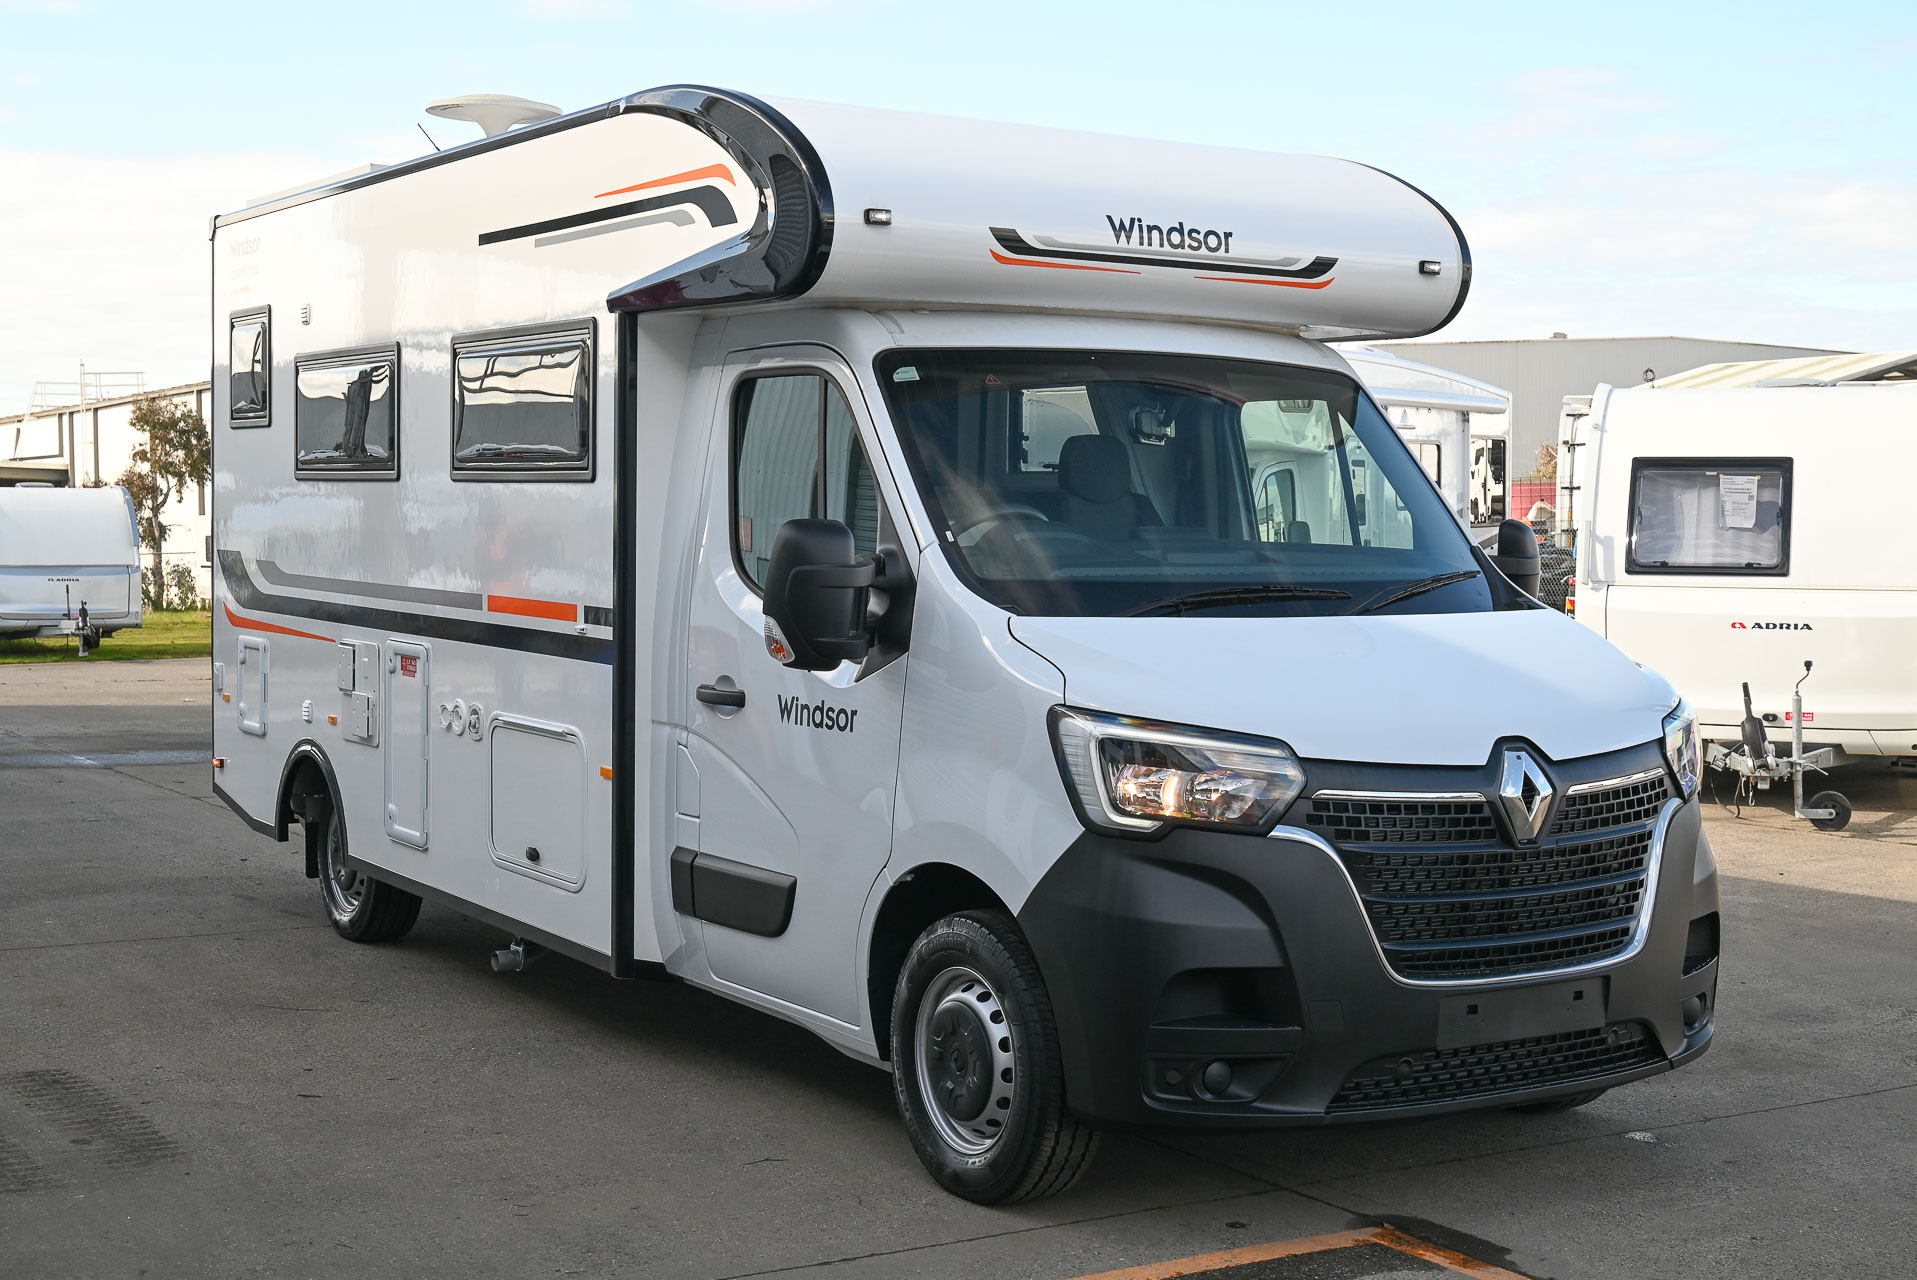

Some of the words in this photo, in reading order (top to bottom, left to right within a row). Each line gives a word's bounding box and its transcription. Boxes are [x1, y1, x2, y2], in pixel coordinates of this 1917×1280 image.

[1105, 214, 1233, 254] Windsor
[1751, 622, 1813, 630] ADRIA
[777, 694, 858, 733] Windsor
